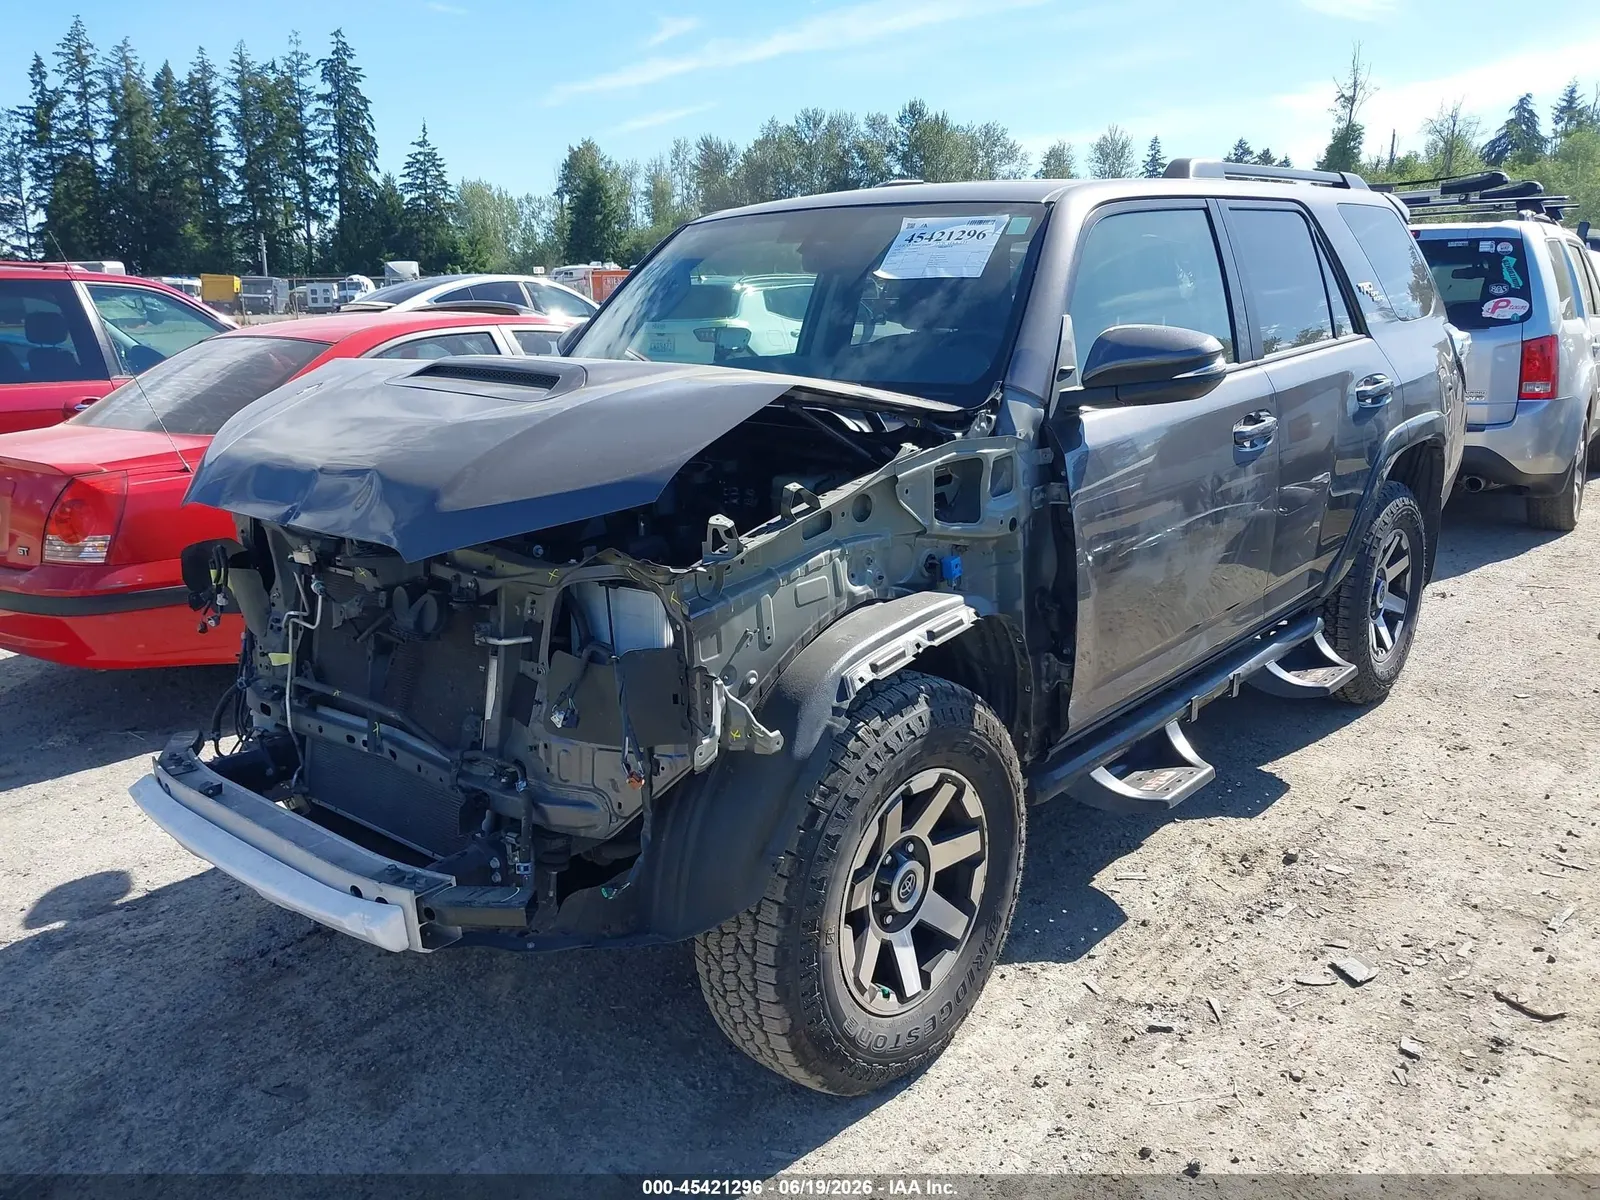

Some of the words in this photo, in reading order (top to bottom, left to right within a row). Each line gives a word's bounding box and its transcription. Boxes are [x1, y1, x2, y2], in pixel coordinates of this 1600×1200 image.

[904, 229, 987, 244] 45421296
[17, 546, 30, 556] GT
[843, 911, 1002, 1054] BRIDGESTONE
